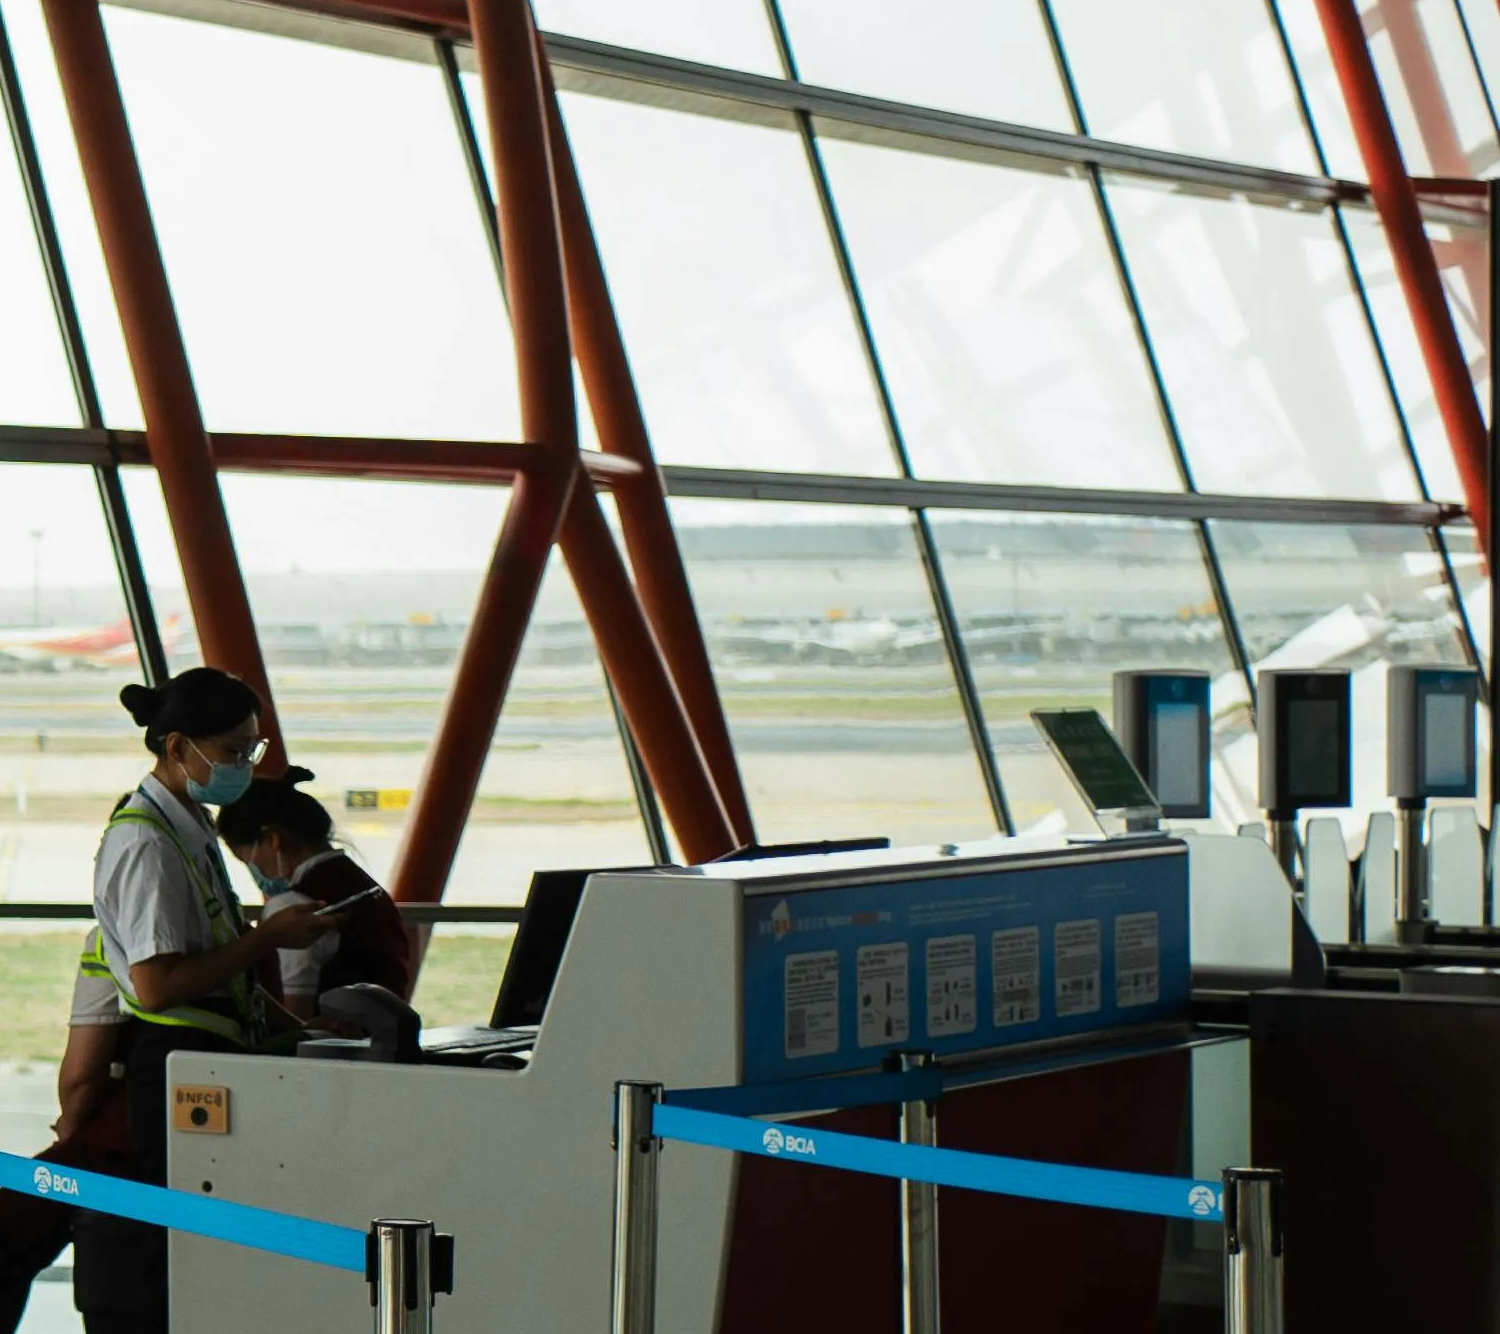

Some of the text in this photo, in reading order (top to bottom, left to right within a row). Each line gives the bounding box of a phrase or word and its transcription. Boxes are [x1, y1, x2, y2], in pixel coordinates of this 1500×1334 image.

[186, 1094, 213, 1104] NFC
[785, 1135, 816, 1155] BCIA
[53, 1174, 79, 1196] BCIA
